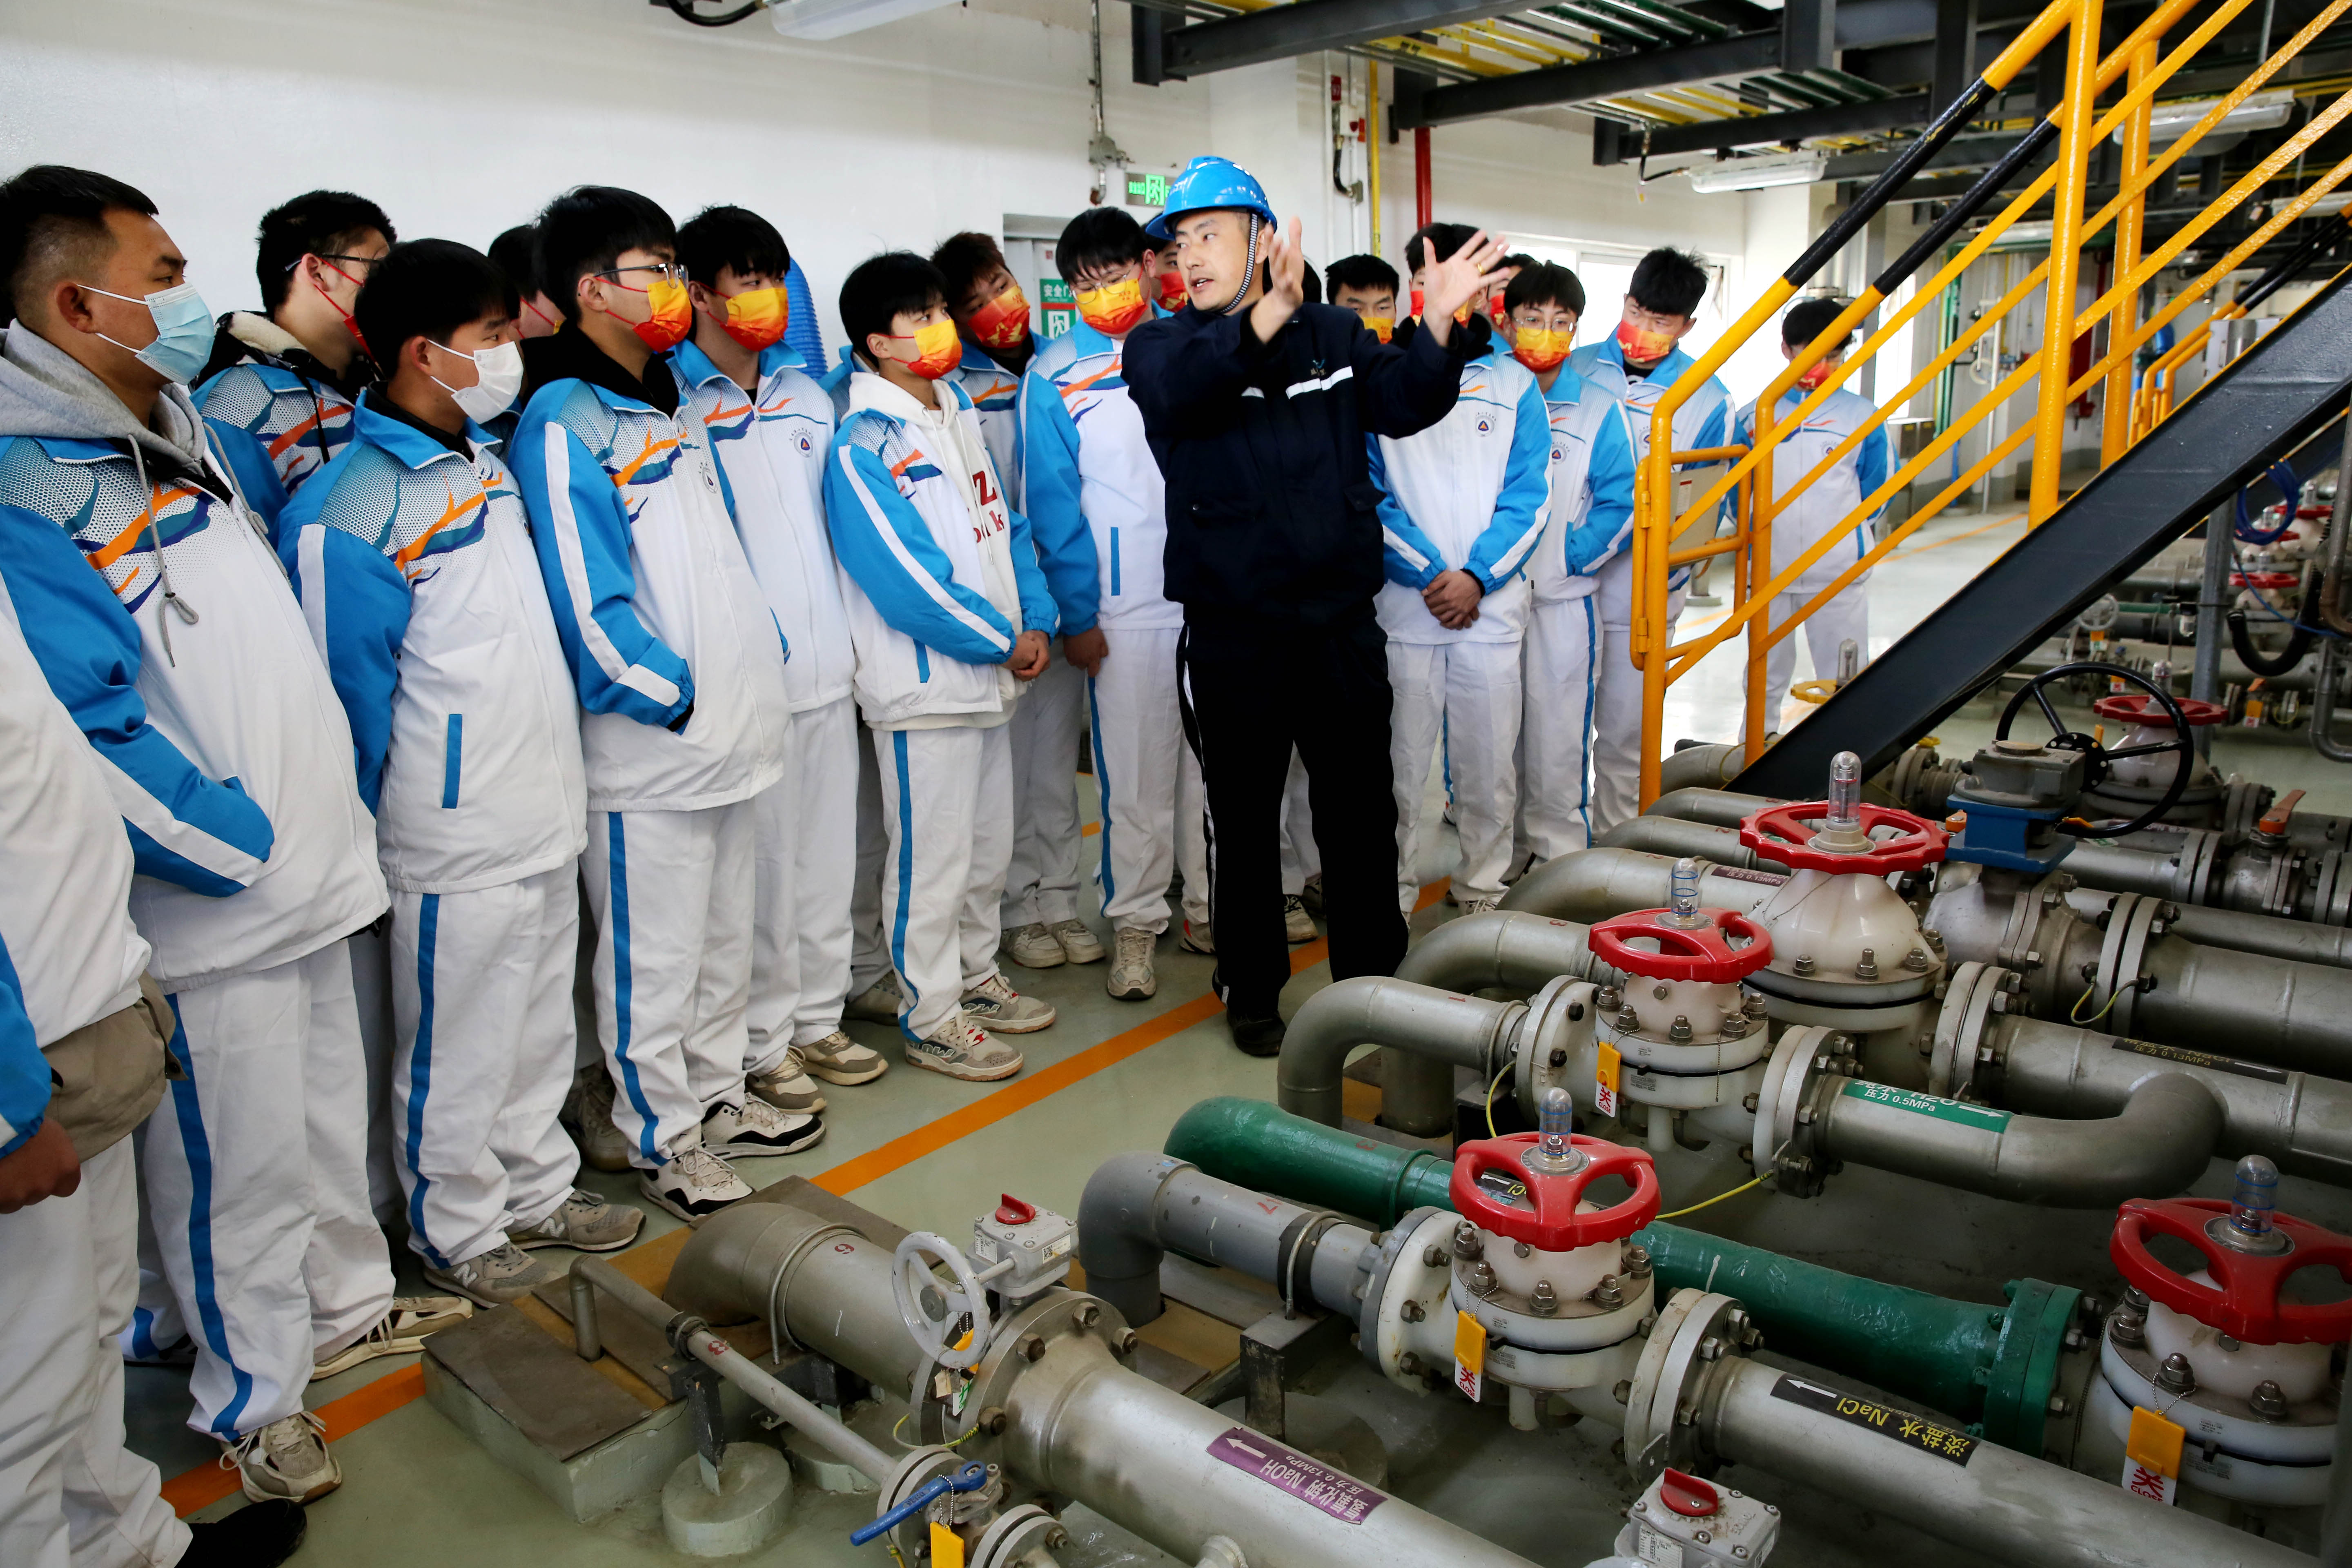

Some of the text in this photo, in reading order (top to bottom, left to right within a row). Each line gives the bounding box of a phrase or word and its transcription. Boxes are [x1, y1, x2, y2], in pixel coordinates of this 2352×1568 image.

[1746, 875, 1781, 884] 0.13MPa
[2134, 1045, 2210, 1065] 压力 0.13MPa
[1598, 1102, 1611, 1114] CLOSE
[1599, 1087, 1611, 1108] 关
[1864, 1088, 1936, 1111] 压力 0.5MPa
[1459, 1381, 1475, 1399] CLOSE
[1460, 1366, 1475, 1392] 关
[1836, 1398, 1970, 1457] 淡盐水 NaCl
[1286, 1455, 1363, 1494] 压力 0.13MPa
[2132, 1467, 2164, 1498] 关
[1260, 1459, 1368, 1519] 氢氧化钠 NaOH
